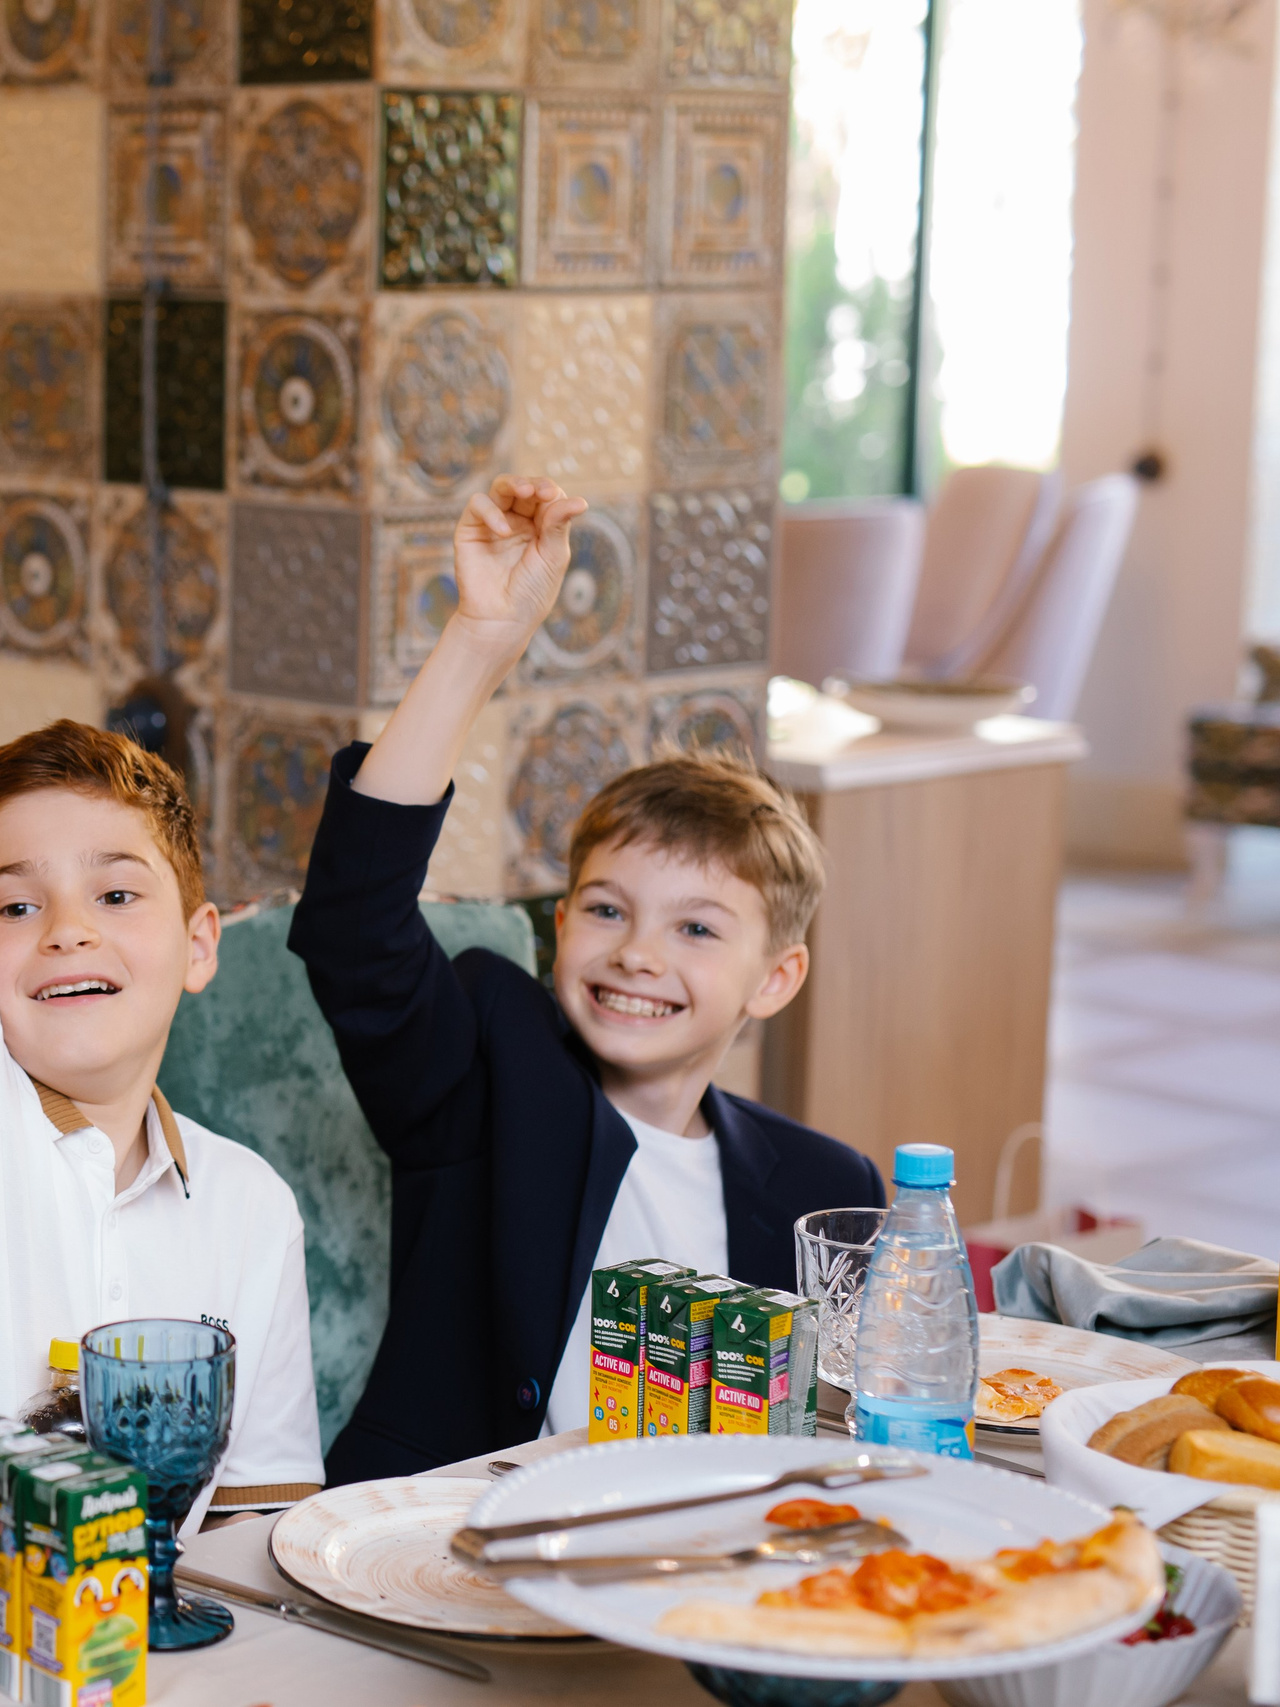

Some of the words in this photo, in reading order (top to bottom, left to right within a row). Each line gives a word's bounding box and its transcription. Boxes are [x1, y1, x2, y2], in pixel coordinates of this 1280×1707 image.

[201, 1314, 229, 1332] BOSS
[593, 1317, 618, 1330] 100%
[648, 1332, 670, 1346] 100%
[594, 1354, 618, 1371] ACTIVE
[618, 1360, 630, 1374] KID
[716, 1350, 745, 1362] 100%
[648, 1369, 670, 1387] ACTIVE
[670, 1376, 681, 1392] KID
[718, 1388, 746, 1405] ACTIVE
[747, 1396, 760, 1409] KID
